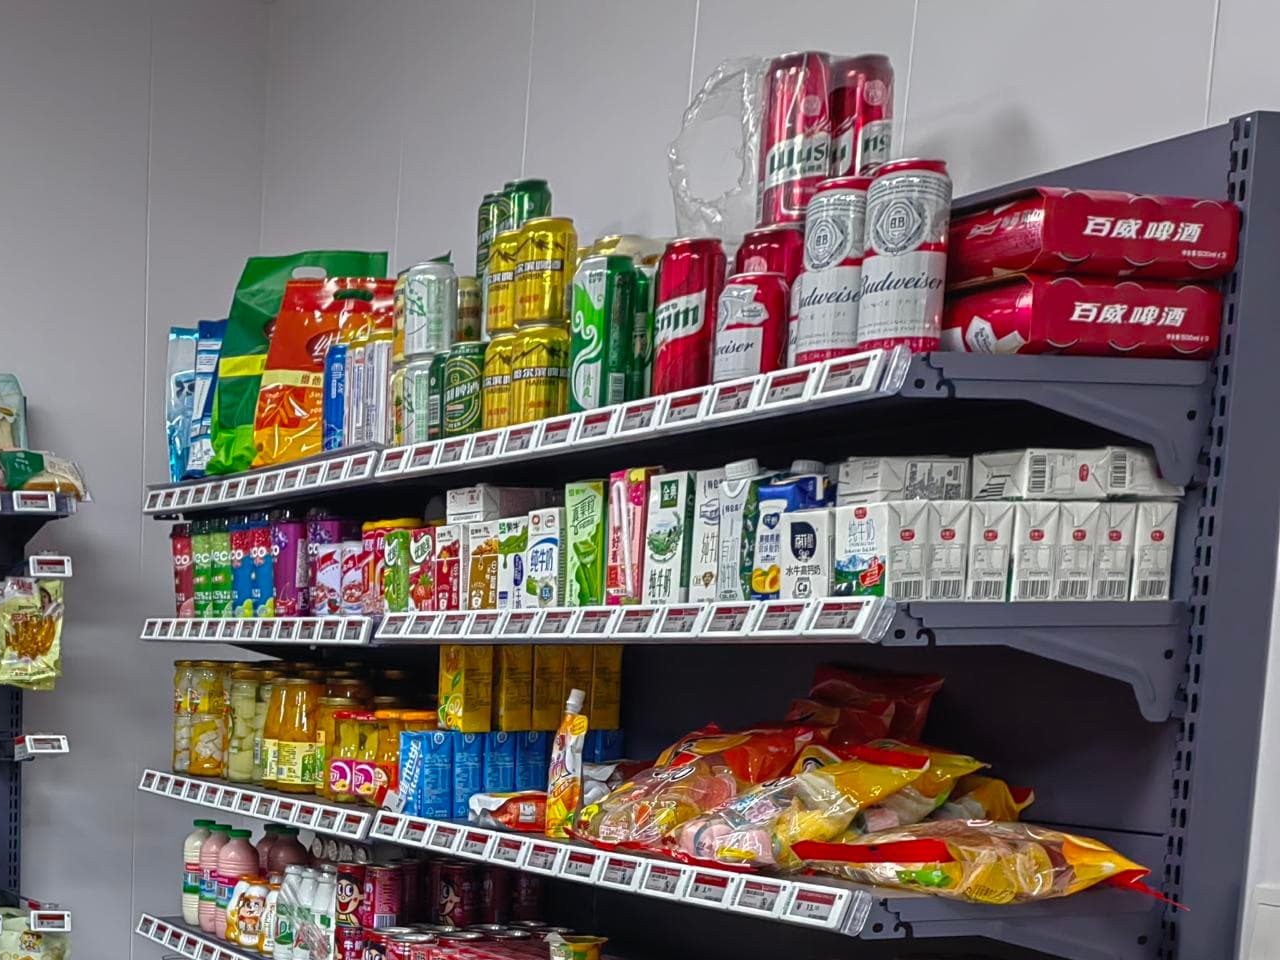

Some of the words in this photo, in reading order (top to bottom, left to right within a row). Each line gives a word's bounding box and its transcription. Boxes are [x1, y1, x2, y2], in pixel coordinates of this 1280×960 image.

[1083, 216, 1203, 243] 百威啤酒
[1071, 302, 1188, 327] 百威啤酒
